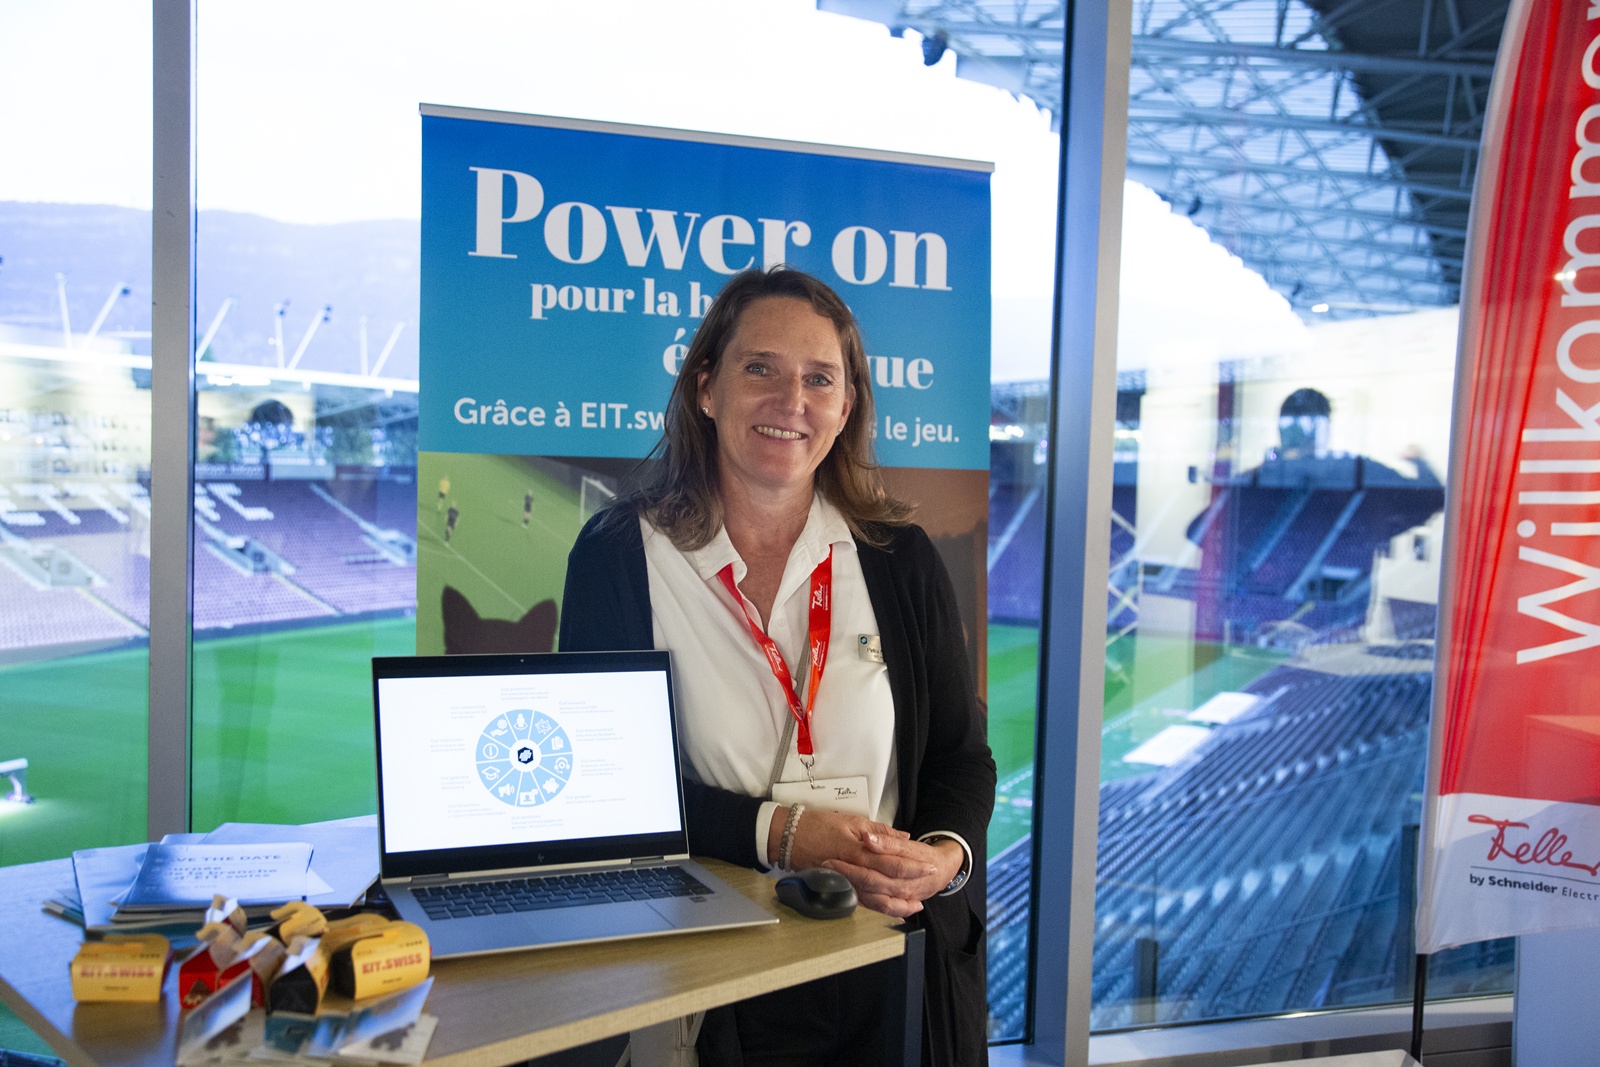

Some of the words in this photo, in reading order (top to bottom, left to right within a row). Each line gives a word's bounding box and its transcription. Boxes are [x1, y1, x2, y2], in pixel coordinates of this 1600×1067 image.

[468, 166, 812, 275] Power
[831, 225, 952, 291] on
[530, 282, 635, 320] pour
[643, 277, 681, 317] la
[453, 397, 546, 426] Grâce
[554, 401, 570, 427] à
[581, 402, 667, 430] EIT.sw
[885, 415, 907, 440] le
[912, 416, 960, 447] jeu.
[1469, 873, 1485, 886] by
[1488, 875, 1558, 894] Schneider
[1561, 886, 1600, 901] Electr
[362, 953, 422, 975] EIT.SWISS
